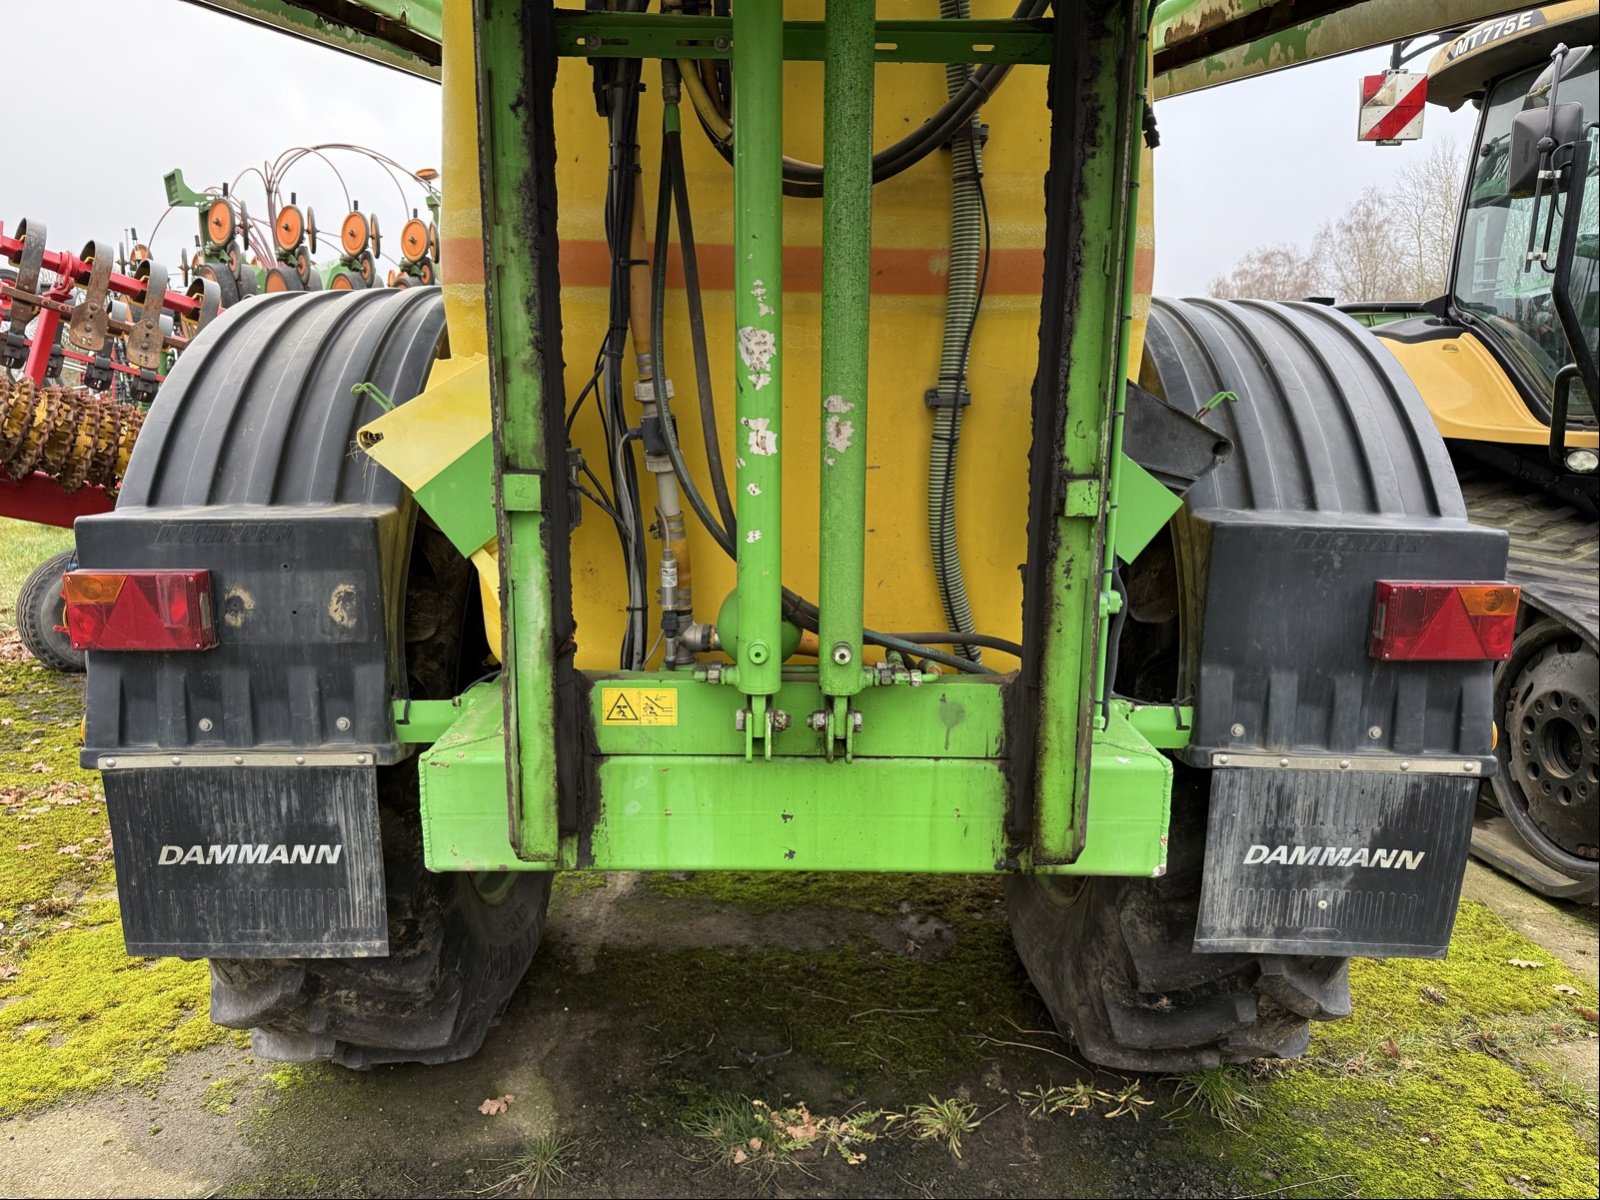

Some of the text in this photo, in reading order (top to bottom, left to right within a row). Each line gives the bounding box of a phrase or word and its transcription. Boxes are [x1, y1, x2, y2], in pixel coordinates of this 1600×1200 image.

[1453, 9, 1534, 57] MT775E
[157, 843, 342, 866] DAMMANN
[1242, 844, 1426, 870] DAMMANN
